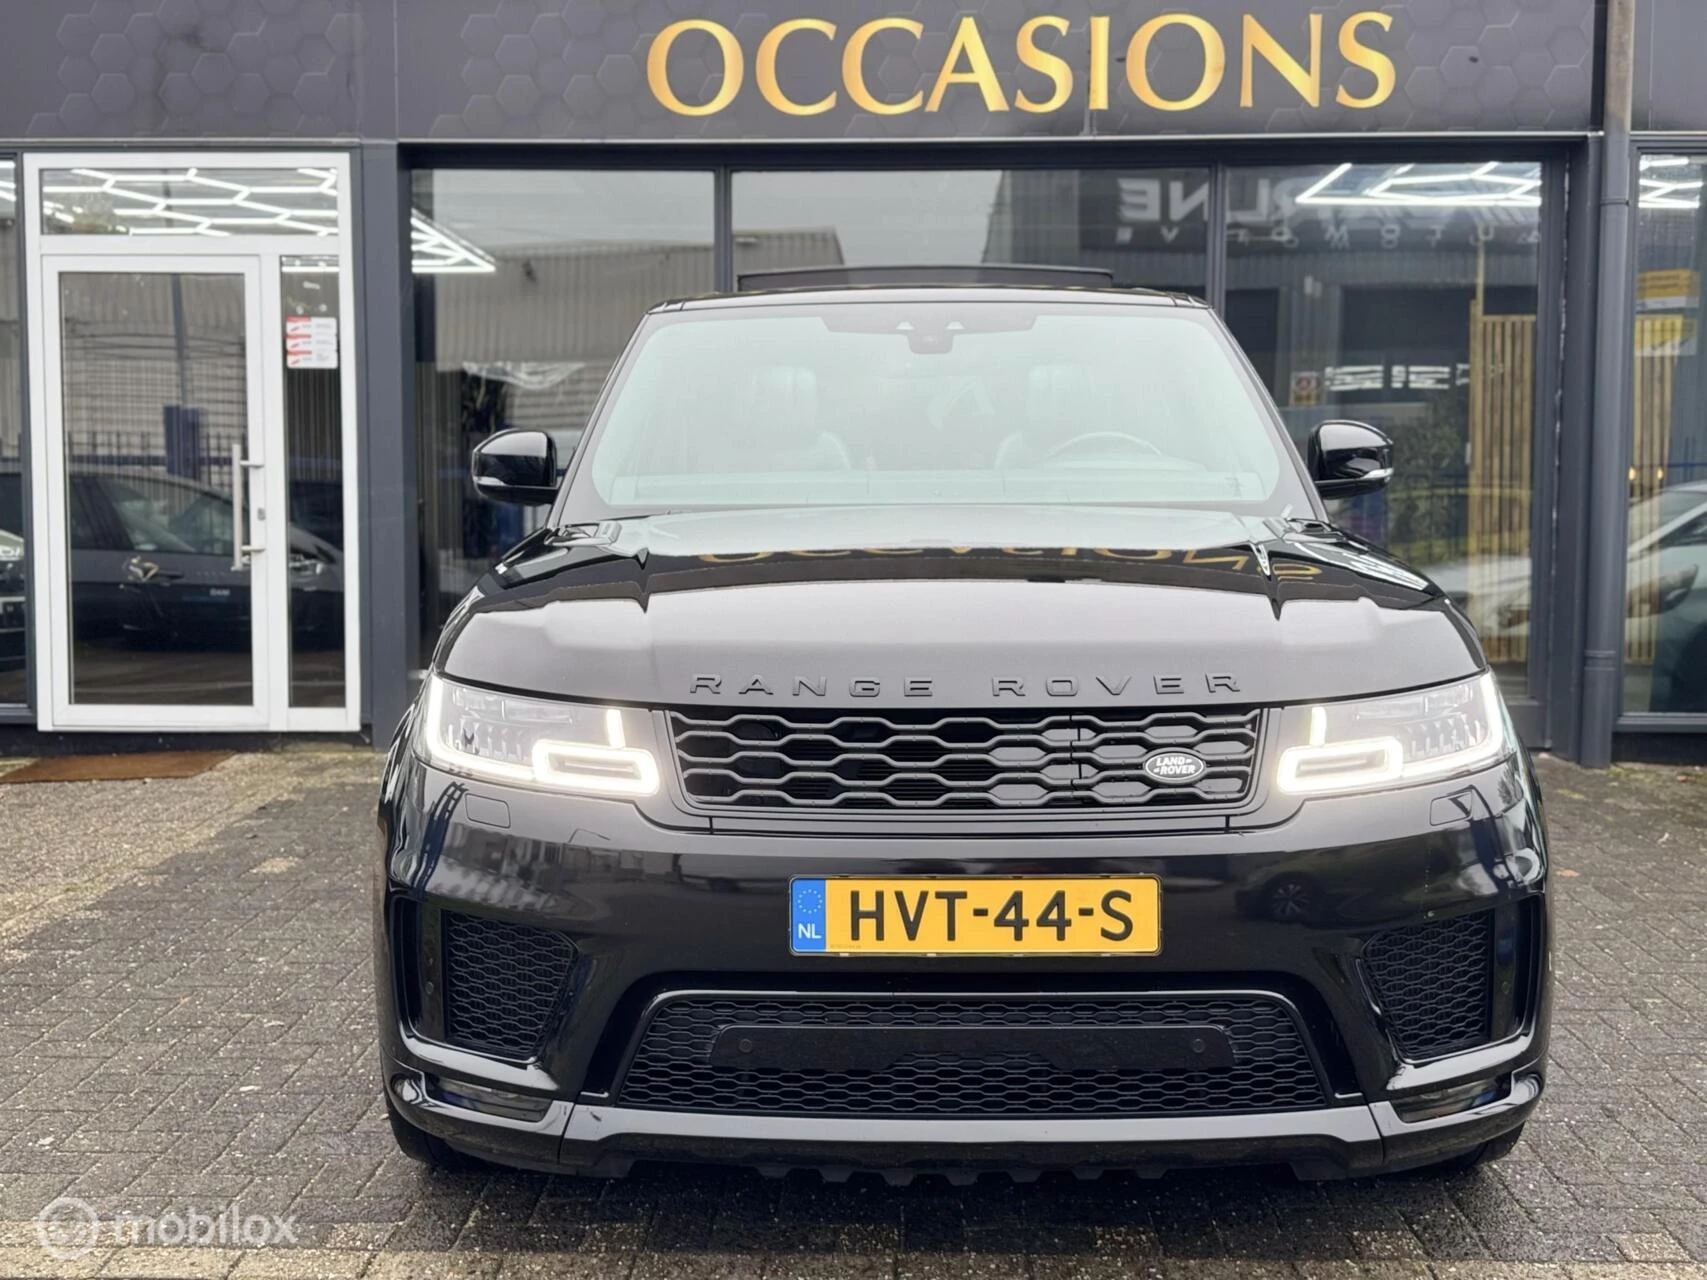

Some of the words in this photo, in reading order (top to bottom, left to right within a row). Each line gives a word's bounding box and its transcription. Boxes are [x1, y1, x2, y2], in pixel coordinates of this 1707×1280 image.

[646, 12, 1397, 116] OCCASIONS
[689, 673, 933, 698] RANGE
[990, 672, 1241, 697] ROVER
[1156, 756, 1186, 767] LAND
[1159, 764, 1196, 775] ROVER
[850, 889, 1134, 942] HVT-44-S
[797, 923, 822, 939] NL
